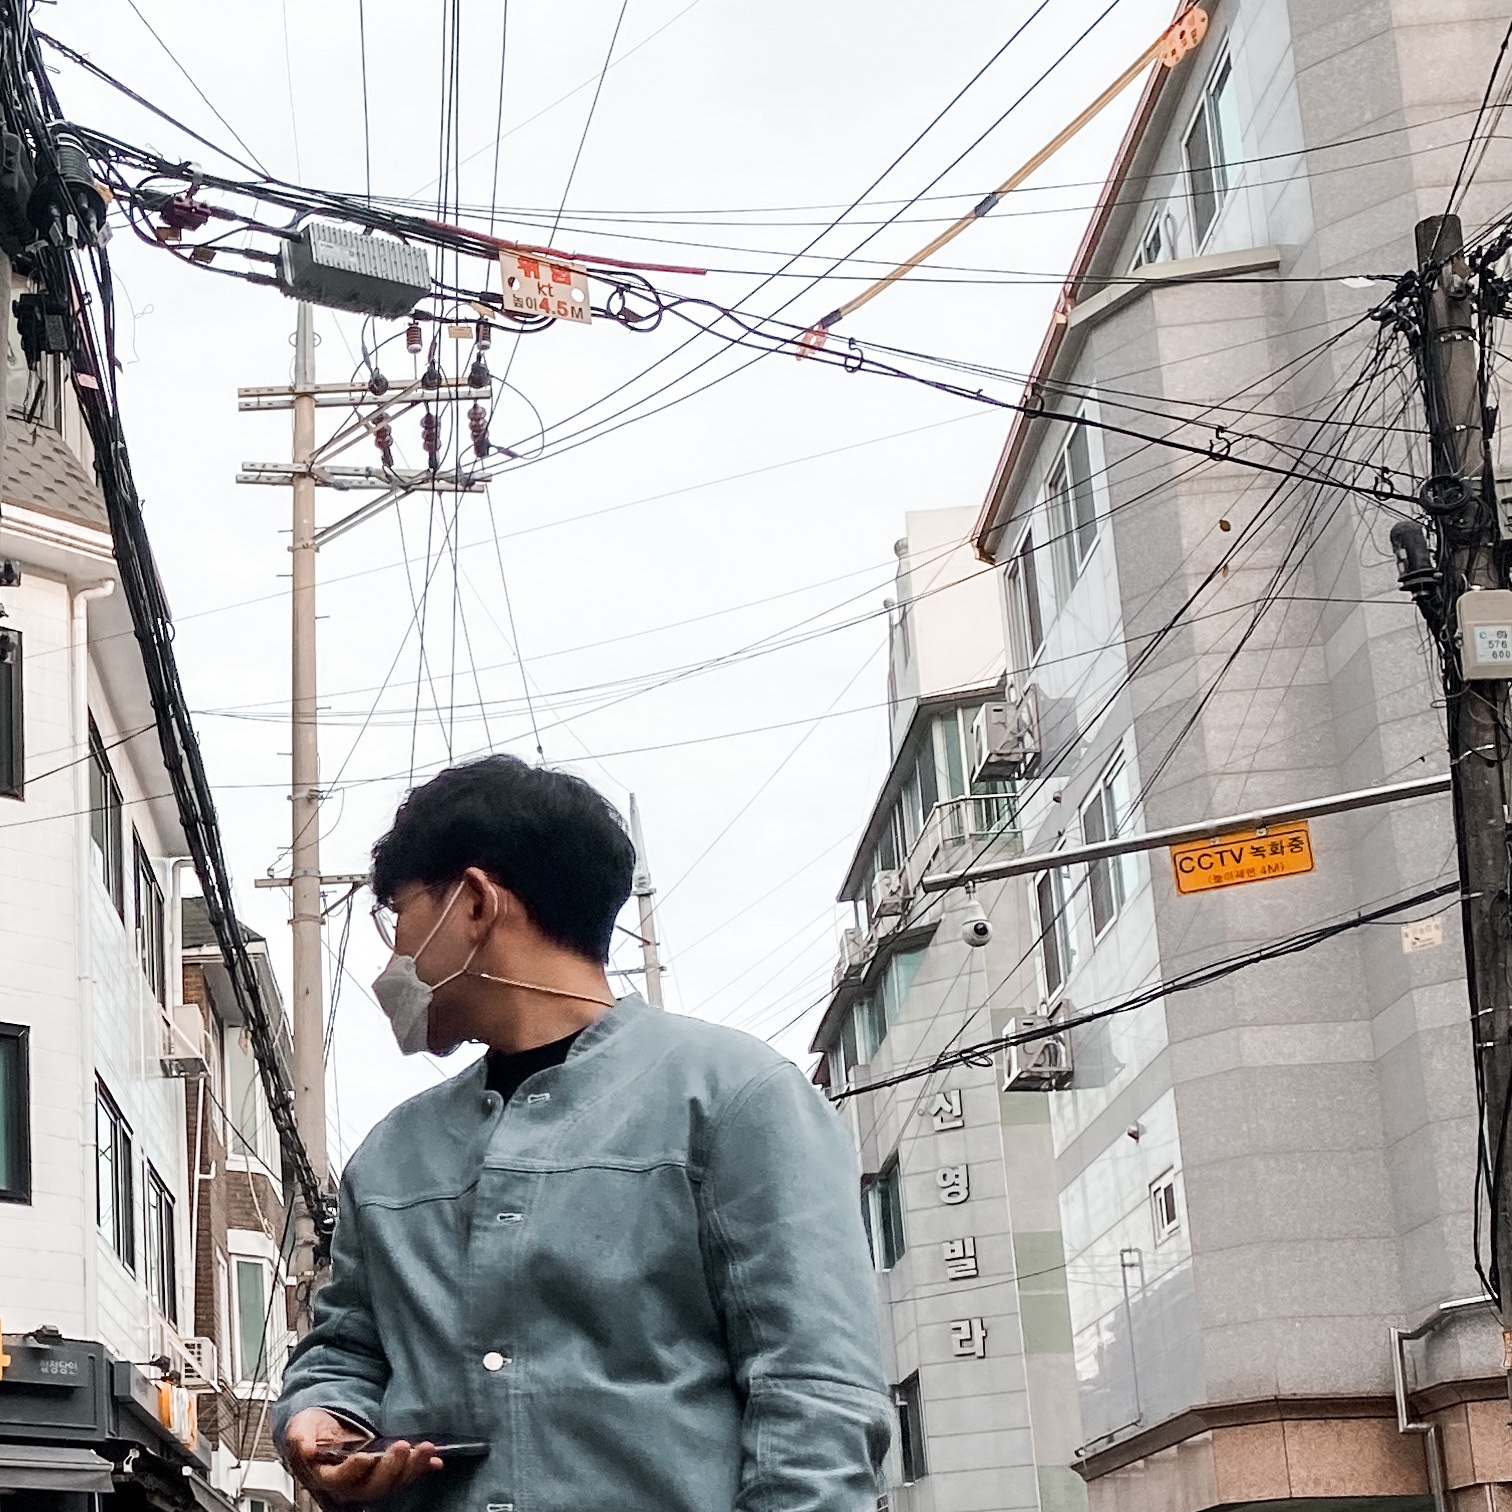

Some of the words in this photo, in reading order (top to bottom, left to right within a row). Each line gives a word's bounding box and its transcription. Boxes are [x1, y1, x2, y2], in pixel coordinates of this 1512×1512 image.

[537, 282, 554, 297] kt
[1179, 847, 1243, 873] CCTV
[1250, 836, 1305, 859] 녹화중
[929, 1089, 988, 1359] 신영빌라
